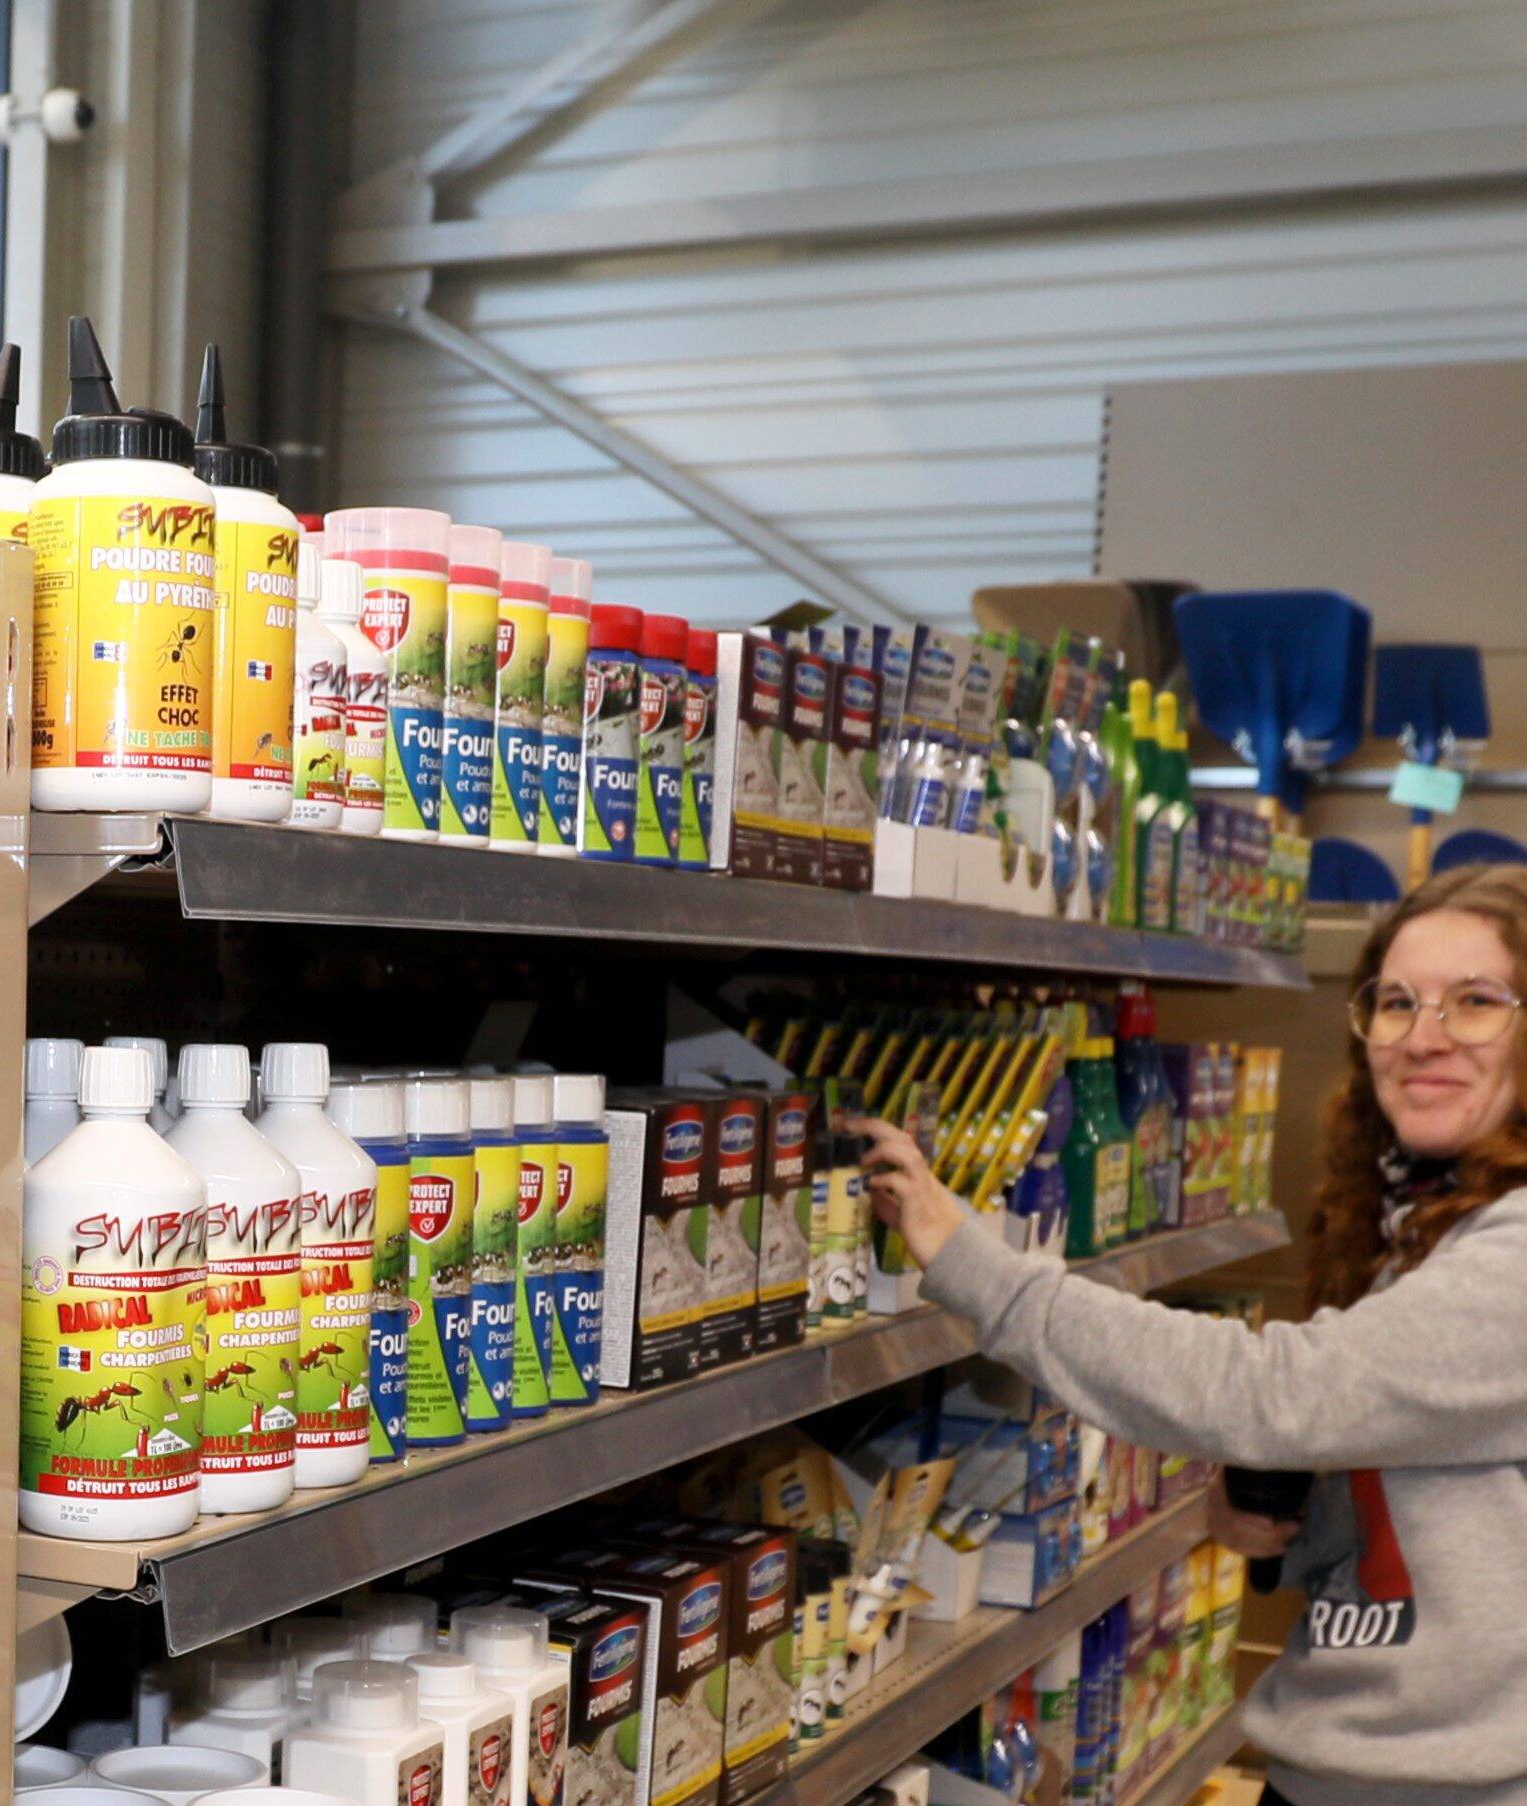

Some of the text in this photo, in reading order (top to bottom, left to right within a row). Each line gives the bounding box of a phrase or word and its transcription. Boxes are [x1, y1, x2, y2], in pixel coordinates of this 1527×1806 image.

[91, 547, 180, 572] POUDRE
[364, 597, 408, 614] PROTECT
[364, 612, 404, 630] EXPERT
[161, 685, 198, 705] EFFET
[158, 708, 199, 727] CHOC
[73, 1273, 141, 1289] DESTRUCTION
[57, 1295, 153, 1334] RADICAL
[117, 1325, 184, 1349] FOURMIS
[67, 1476, 178, 1494] DÉTRUIT TOUS LES
[1311, 1600, 1404, 1648] ROOT
